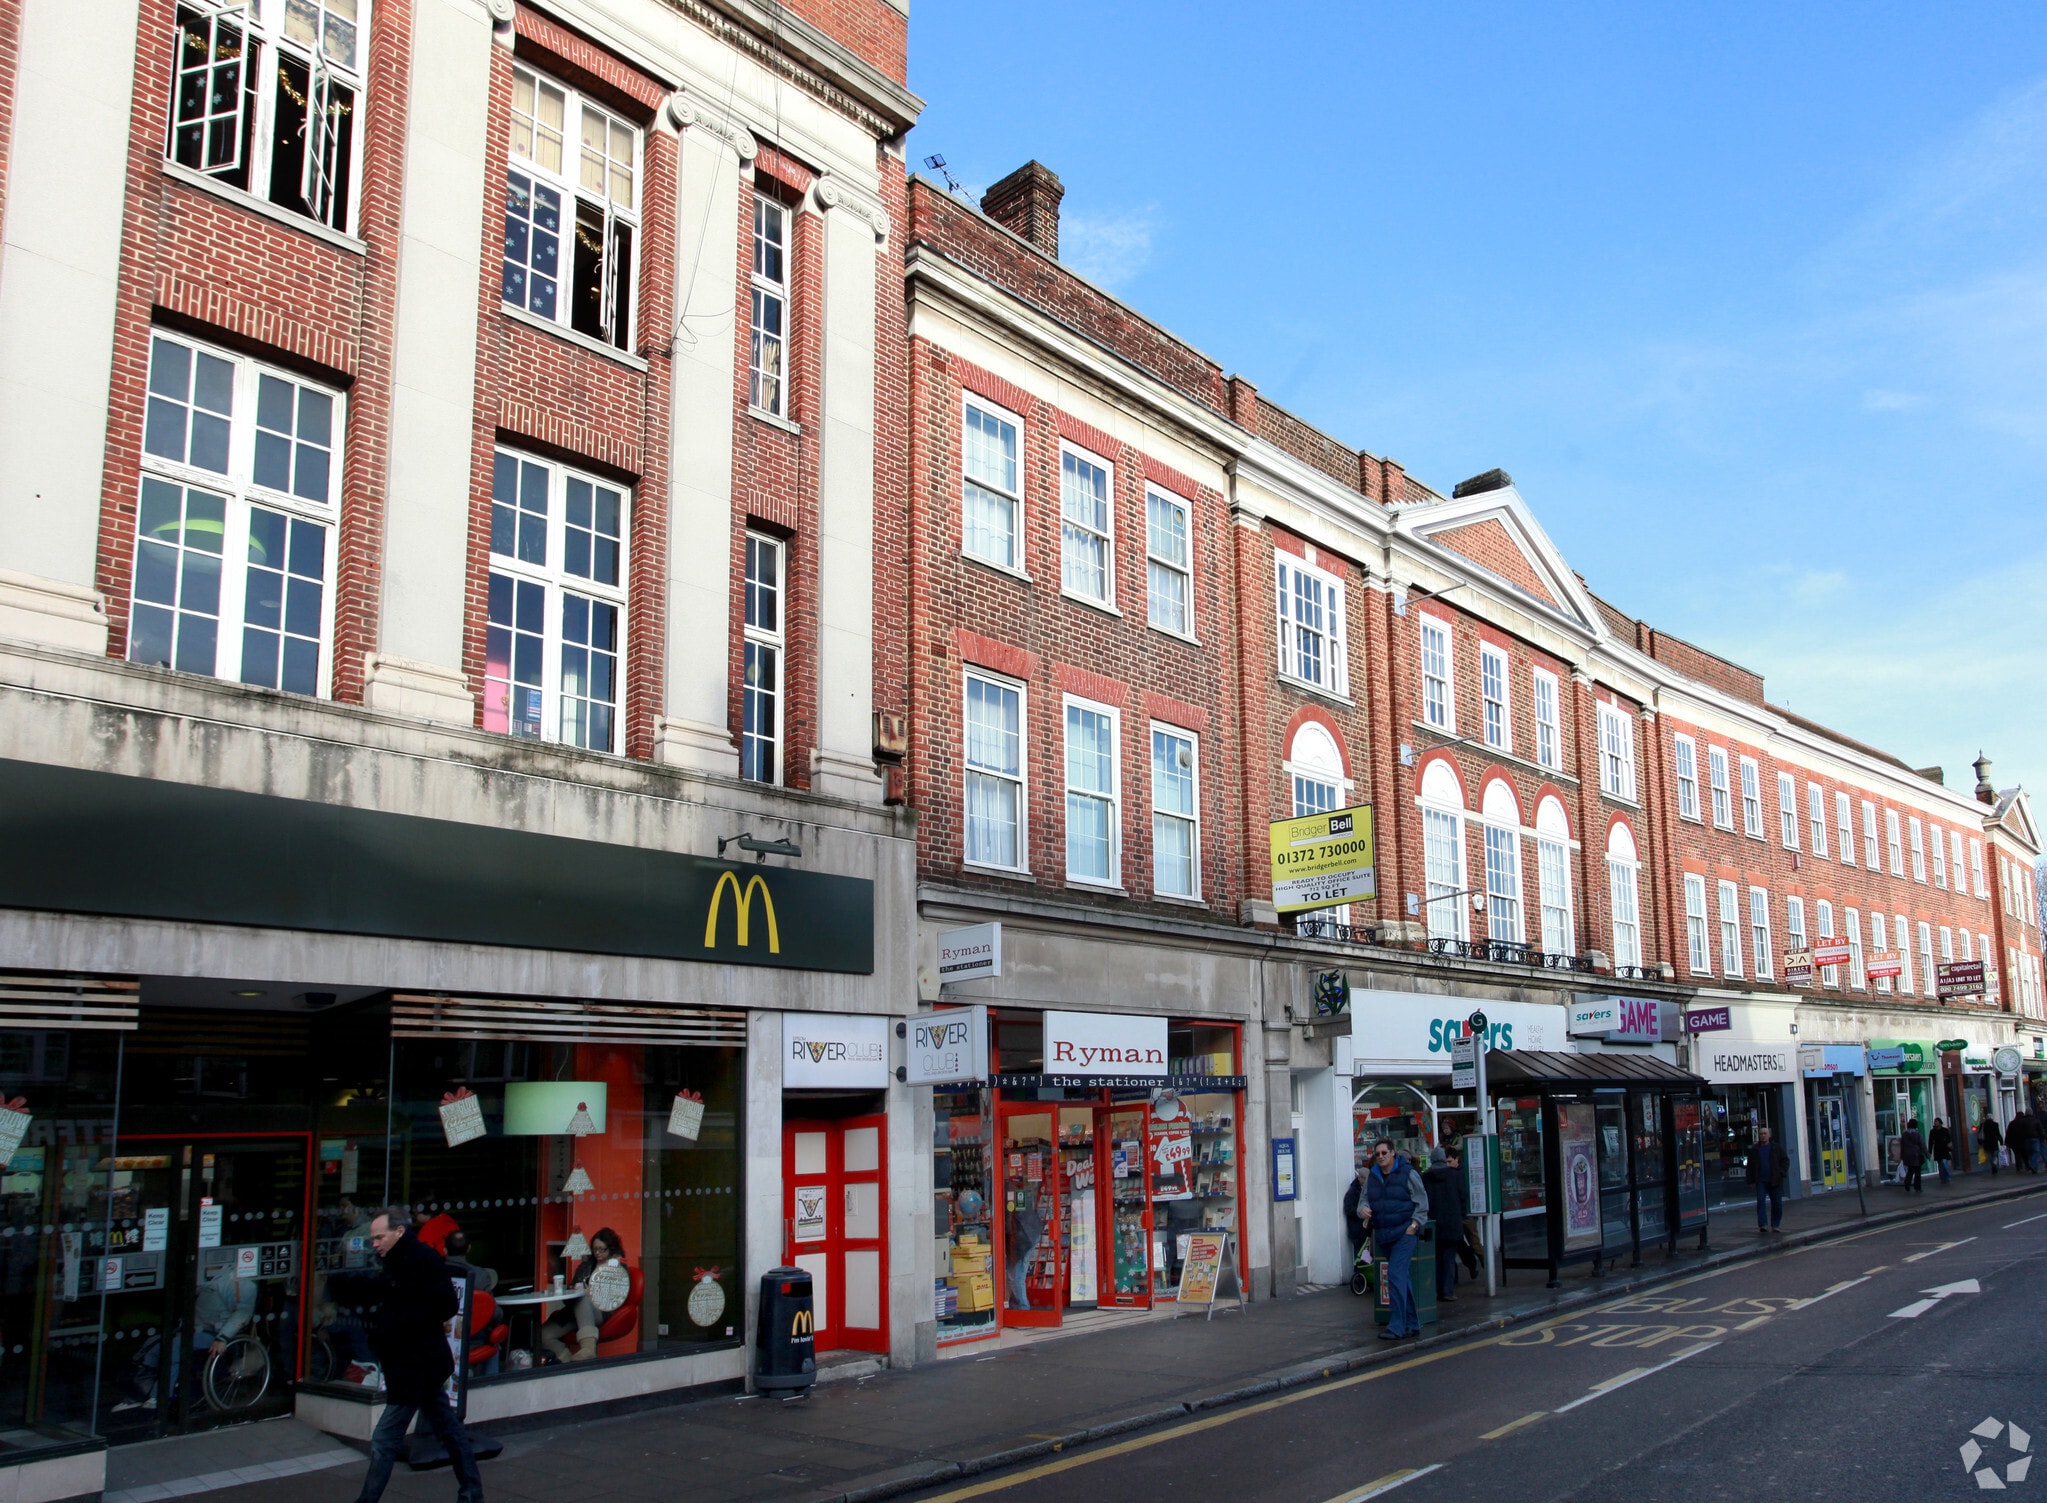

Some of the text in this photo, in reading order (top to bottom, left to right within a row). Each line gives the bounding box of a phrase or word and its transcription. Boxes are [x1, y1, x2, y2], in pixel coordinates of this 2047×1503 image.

[1291, 817, 1352, 838] Bridger Bell
[1277, 839, 1366, 865] 01372 730000
[1288, 858, 1357, 874] www.bridgerbell.com
[1291, 877, 1314, 885] READY
[1328, 871, 1355, 879] OCCUPY
[1295, 881, 1326, 889] QUALITY
[1328, 877, 1351, 885] OFFICE
[1353, 873, 1371, 881] SUITE
[1302, 888, 1347, 902] TO LET
[942, 943, 992, 960] Ryman
[956, 960, 992, 971] stationer
[1576, 1009, 1611, 1021] savers
[1690, 1012, 1727, 1028] GAME
[915, 1022, 968, 1050] RIVER
[792, 1041, 879, 1063] RIVER CLUB
[1053, 1041, 1164, 1067] Ryman
[923, 1052, 954, 1071] CLUB
[1714, 1053, 1778, 1072] HEADMASTERS
[1052, 1076, 1081, 1087] the
[1089, 1076, 1165, 1087] stationer
[1596, 1297, 1802, 1314] BUS
[1498, 1324, 1728, 1348] STOP
